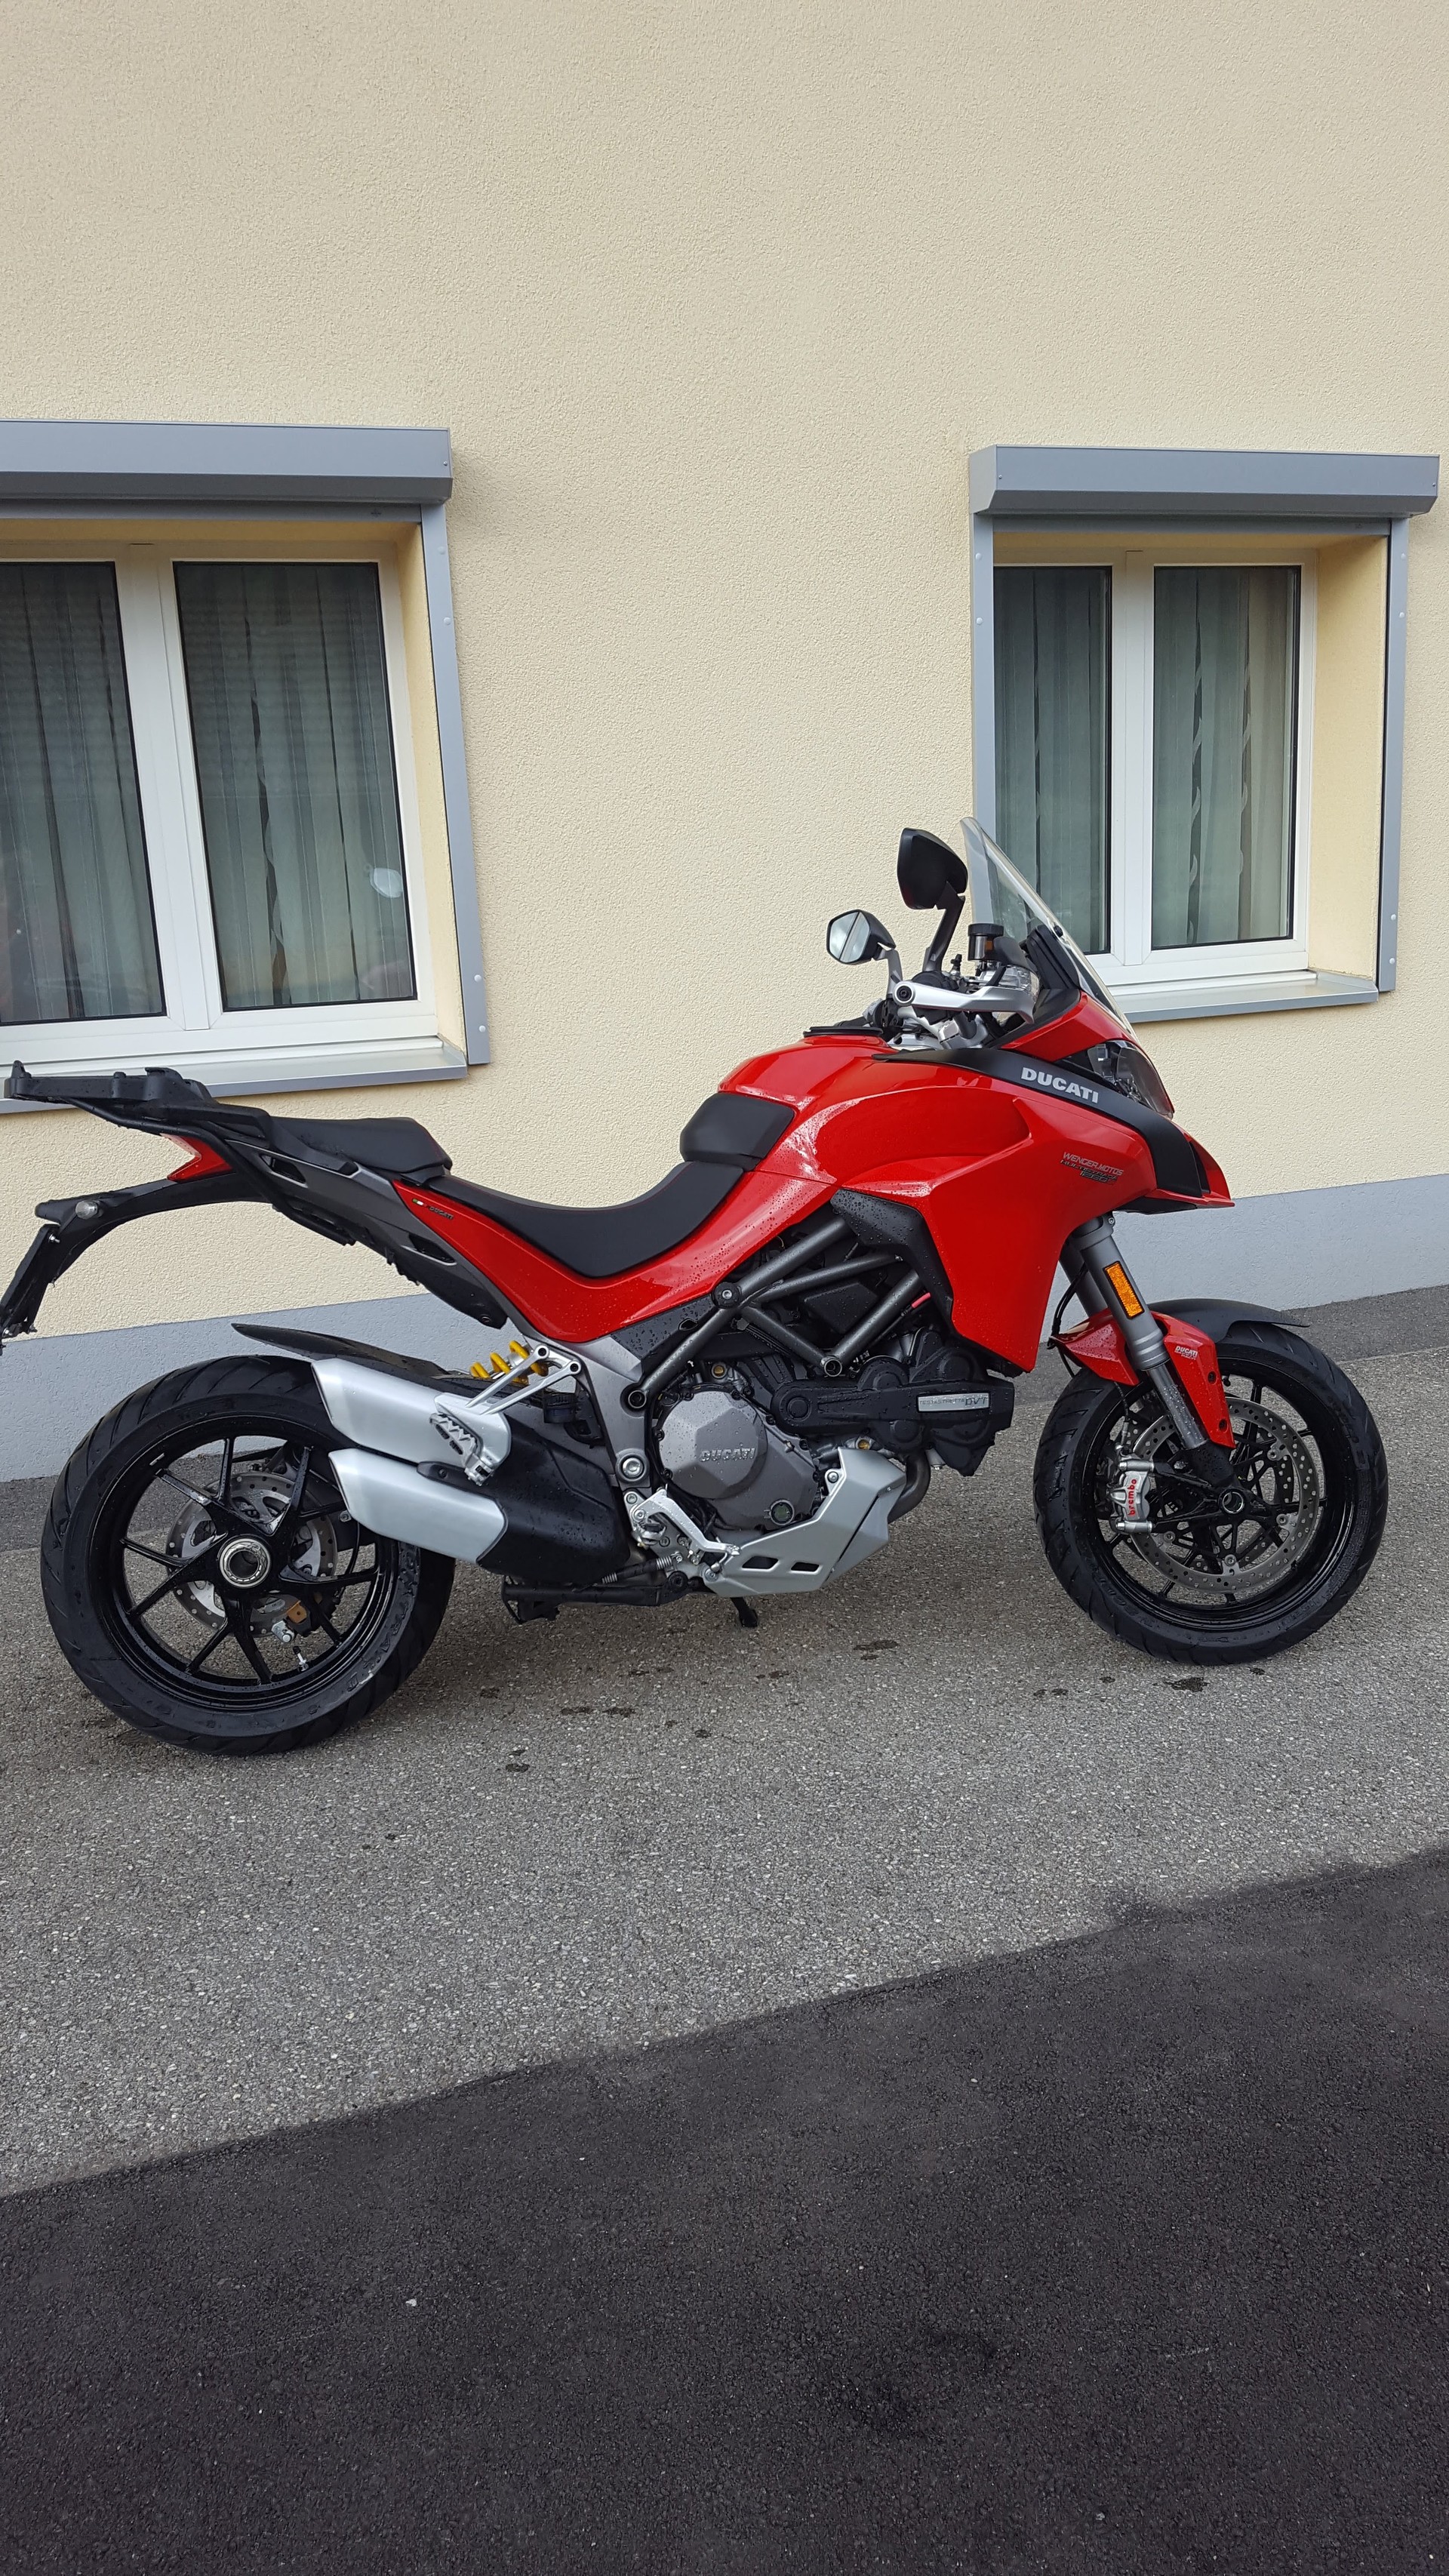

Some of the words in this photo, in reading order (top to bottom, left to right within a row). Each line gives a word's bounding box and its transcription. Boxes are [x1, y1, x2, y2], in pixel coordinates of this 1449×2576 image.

[1021, 1067, 1099, 1103] DUCATI
[1175, 1346, 1198, 1357] DUCATI
[965, 1396, 989, 1405] DVT
[699, 1448, 755, 1462] DUCATI
[1127, 1479, 1137, 1516] brembo
